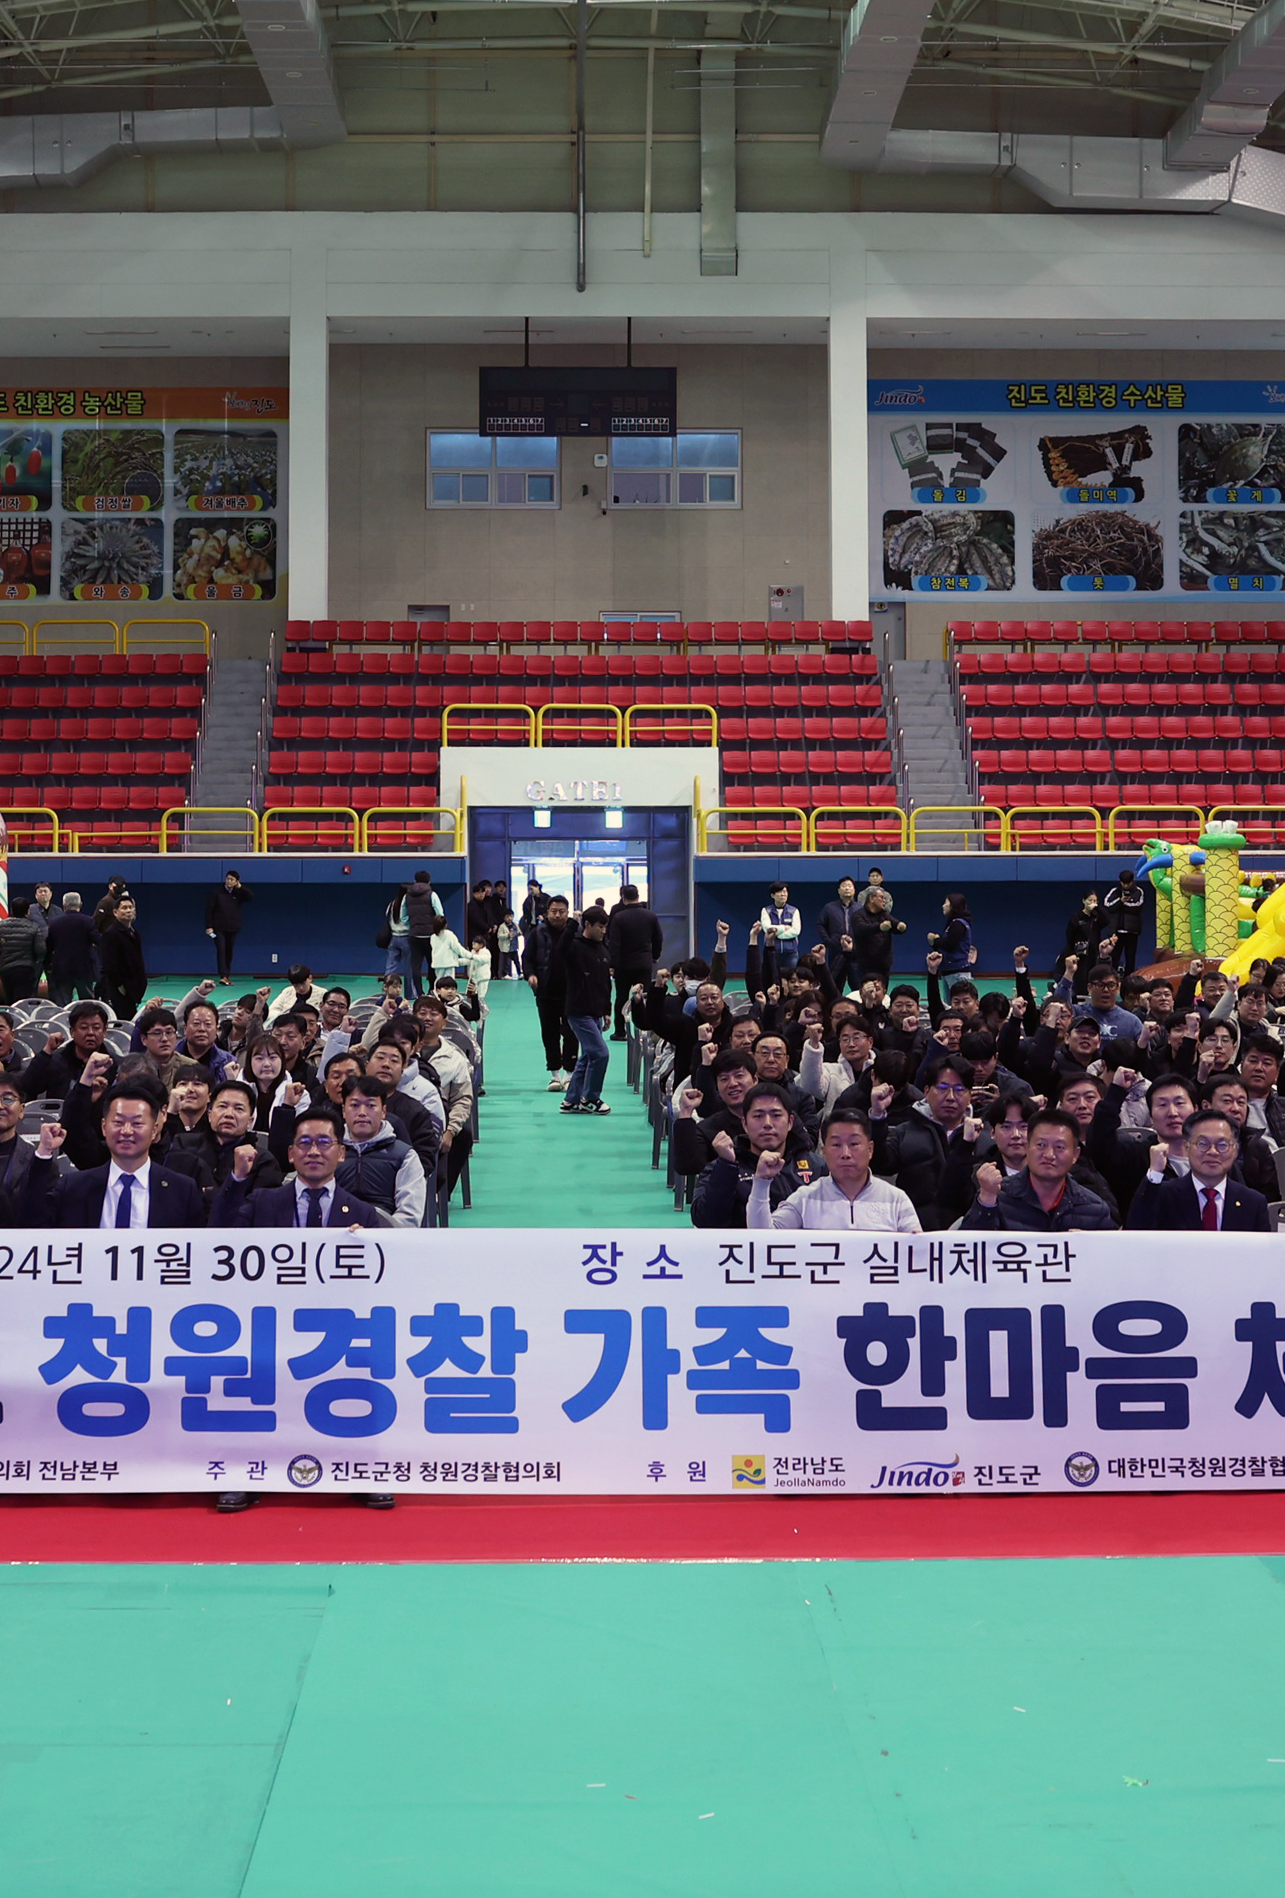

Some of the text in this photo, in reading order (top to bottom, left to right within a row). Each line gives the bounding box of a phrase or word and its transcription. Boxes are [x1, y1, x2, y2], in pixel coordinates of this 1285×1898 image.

[13, 391, 76, 416] 친환경
[81, 390, 145, 416] 농산물
[1007, 384, 1185, 408] 진도 친환경 수산물
[94, 497, 132, 510] 검정쌀
[202, 497, 249, 510] 겨울배추
[930, 576, 971, 590] 참전복
[102, 1242, 193, 1286] 11월
[212, 1241, 386, 1287] 30일(토)
[718, 1240, 845, 1286] 진도군
[862, 1240, 1077, 1286] 실내체육관
[38, 1302, 528, 1438] 청원경찰
[561, 1304, 800, 1433] 가족
[836, 1300, 1198, 1431] 한마음
[38, 1459, 120, 1483] 전남본부
[330, 1460, 412, 1483] 진도군청
[419, 1460, 562, 1484] 청원경찰협의회
[772, 1455, 846, 1476] 전라남도
[870, 1465, 950, 1489] Jindo
[973, 1464, 1041, 1487] 진도군
[773, 1476, 846, 1489] JeollaNamdo
